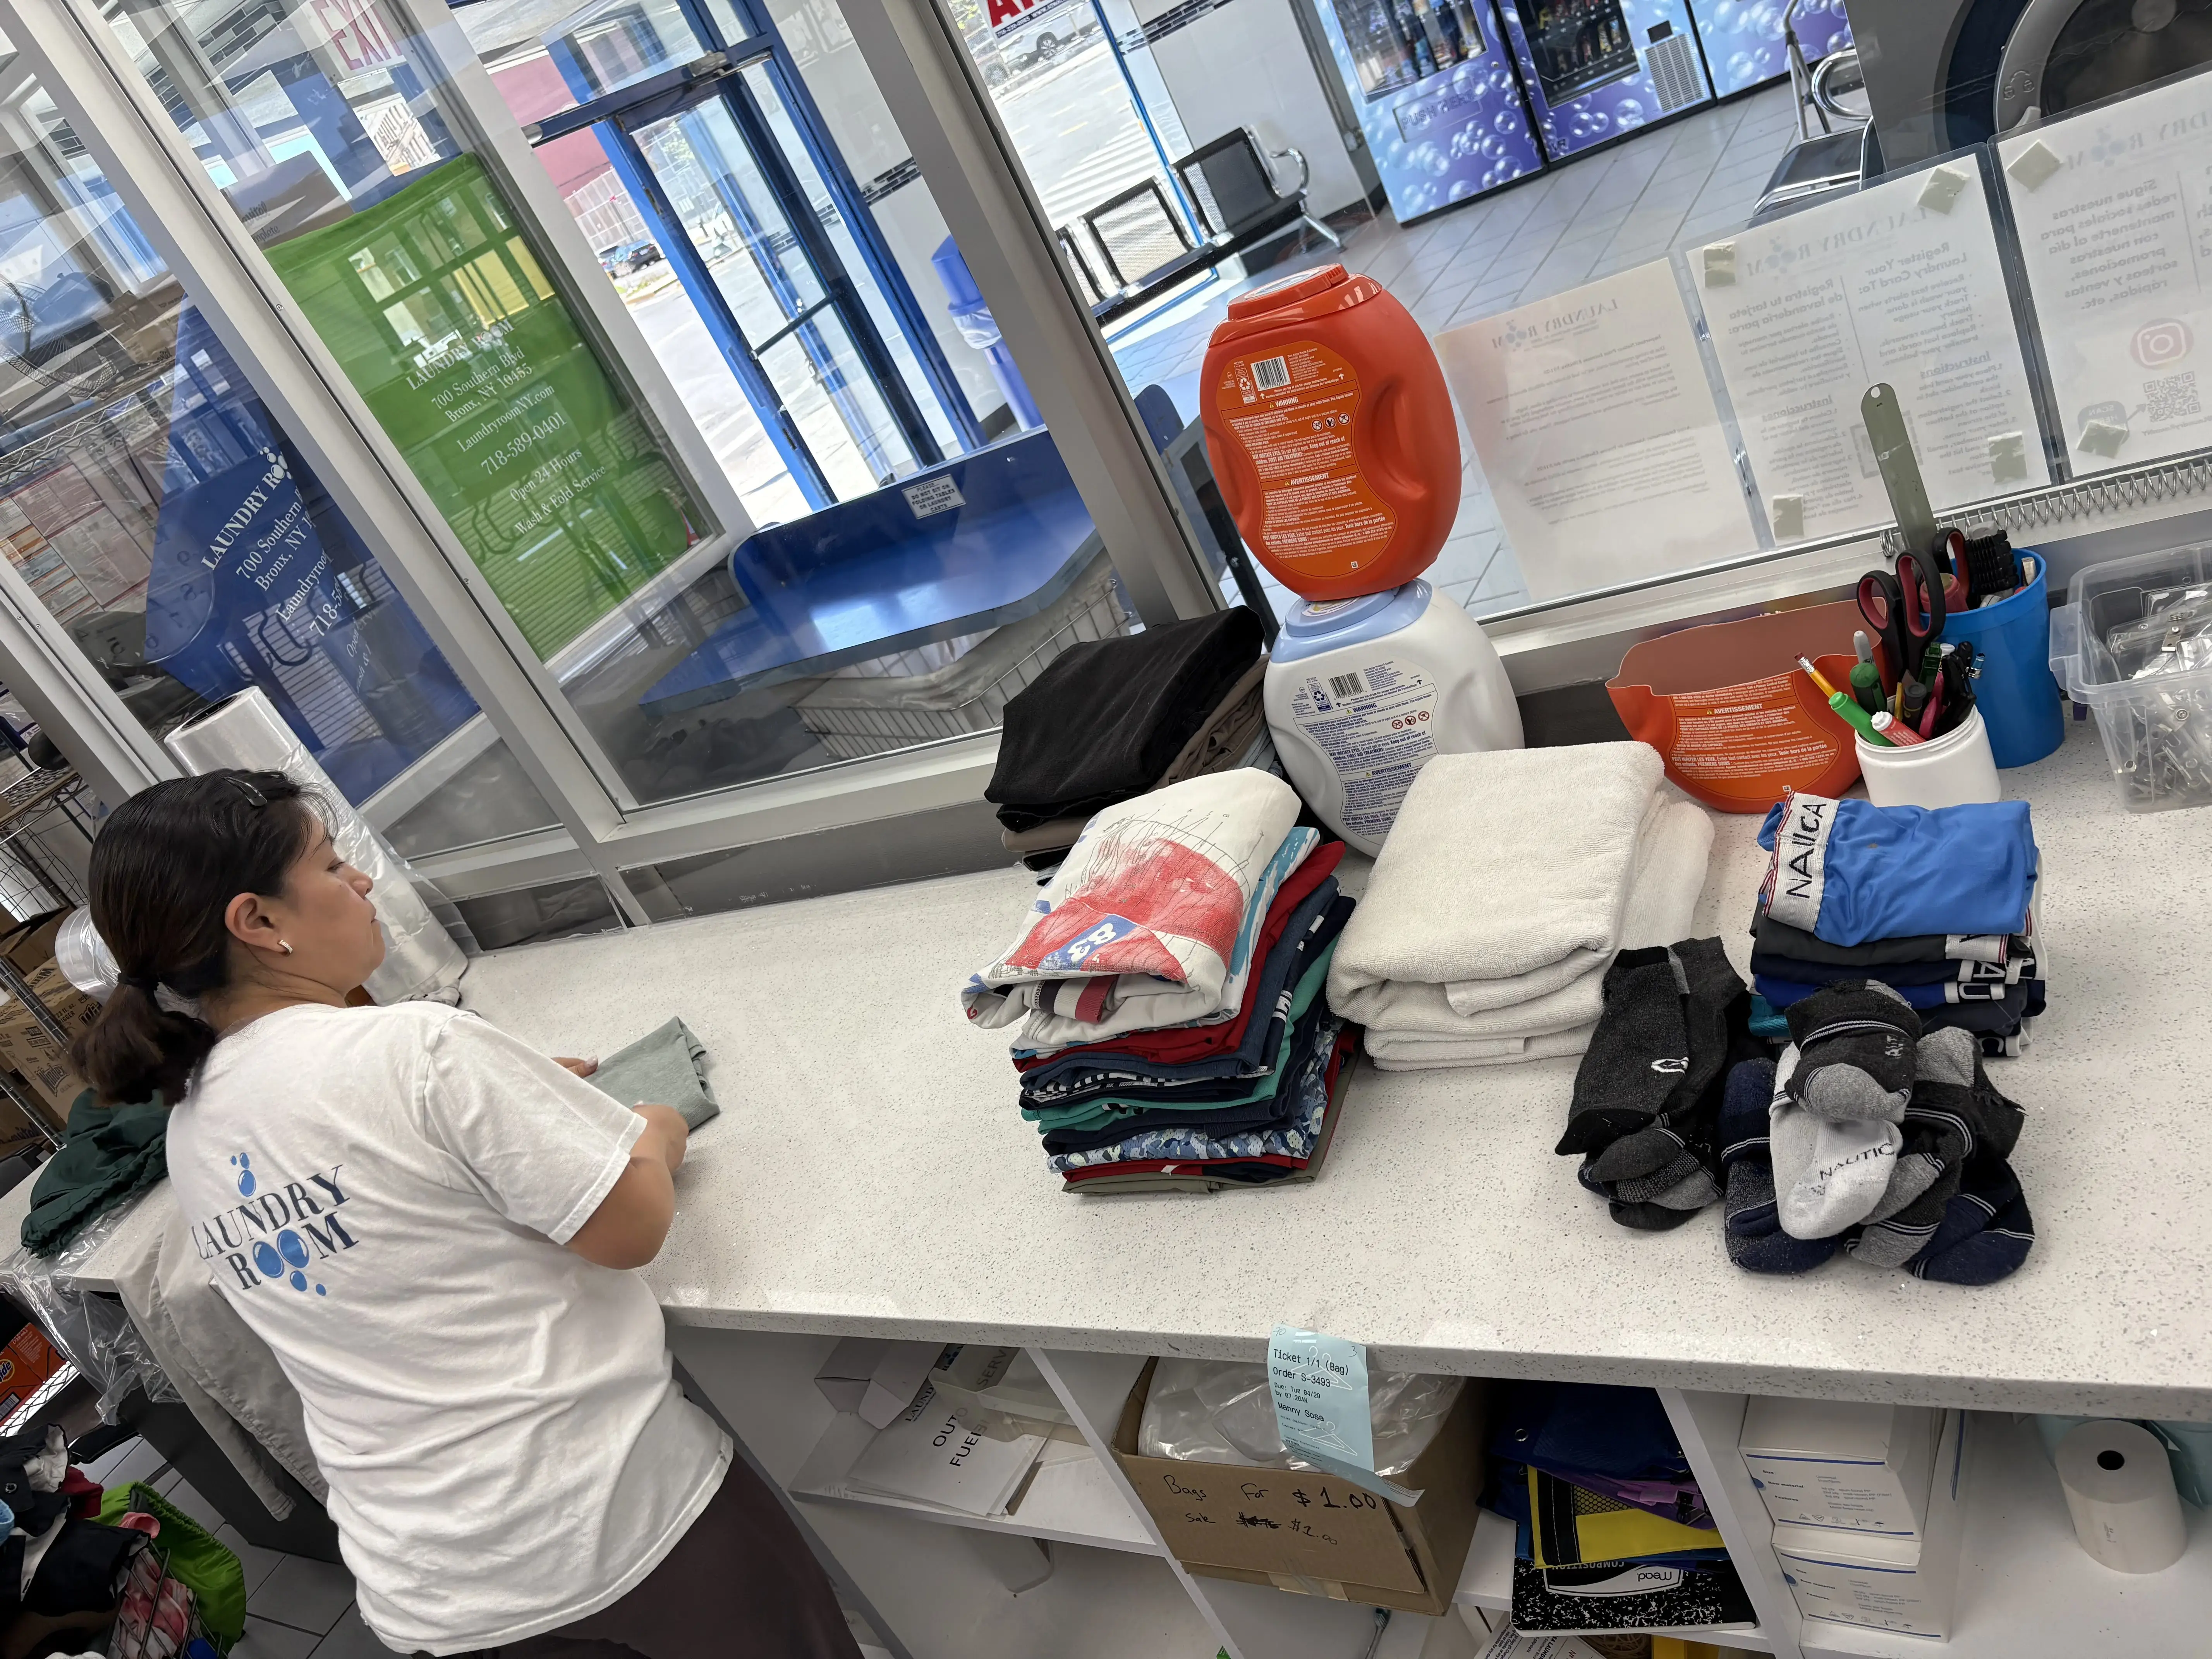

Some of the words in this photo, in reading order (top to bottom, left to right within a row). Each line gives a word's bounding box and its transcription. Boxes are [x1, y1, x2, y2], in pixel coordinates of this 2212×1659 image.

[1398, 105, 1438, 130] PUSH
[1435, 89, 1475, 114] HERE
[405, 341, 473, 391] LAUNDRY
[430, 389, 455, 411] 700
[451, 359, 501, 397] Southern
[499, 345, 525, 369] Blvd
[444, 393, 482, 424] Bronx,
[477, 381, 498, 401] NY
[497, 361, 533, 390] 10455
[1275, 396, 1299, 407] WARNING
[455, 381, 557, 453] LaundryroomNY.com
[478, 410, 569, 476] 718-589-0401
[508, 477, 539, 505] Open
[533, 465, 551, 483] 24
[549, 445, 583, 473] Hours
[1290, 472, 1329, 486] AVERTISSEMENT
[513, 508, 544, 536] Wash
[540, 501, 552, 515] &
[549, 485, 575, 509] Fold
[571, 463, 608, 493] Service
[912, 495, 934, 506] FOLDING
[935, 488, 955, 498] TABLES
[927, 496, 951, 507] LAUNDRY
[930, 503, 947, 512] CARTS
[196, 484, 274, 572] LAUNDRY
[234, 549, 265, 582] 700
[255, 498, 305, 554] Southern
[252, 546, 294, 591] Bronx,
[284, 524, 309, 550] NY
[341, 630, 368, 658] Open
[1352, 703, 1377, 712] WARNING
[1714, 703, 1763, 715] AVERTISSEMENT
[1371, 763, 1412, 776] AVERTISSEMENT
[191, 1164, 350, 1260] LAUNDRY
[225, 1211, 359, 1290] ROOM
[1272, 1348, 1302, 1364] Ticket
[1306, 1357, 1321, 1367] 1/1
[1324, 1360, 1350, 1376] (Bag)
[1348, 1345, 1357, 1358] 3
[1272, 1366, 1297, 1379] Order
[1300, 1373, 1331, 1387] S-3493
[1274, 1382, 1287, 1391] Due:
[1290, 1386, 1301, 1394] Tue
[1276, 1401, 1301, 1416] Manny
[1303, 1410, 1325, 1422] Sosa
[1162, 1474, 1208, 1501] Bags
[1240, 1482, 1269, 1502] For
[1185, 1512, 1216, 1525] Sale
[1550, 1634, 1558, 1642] SA
